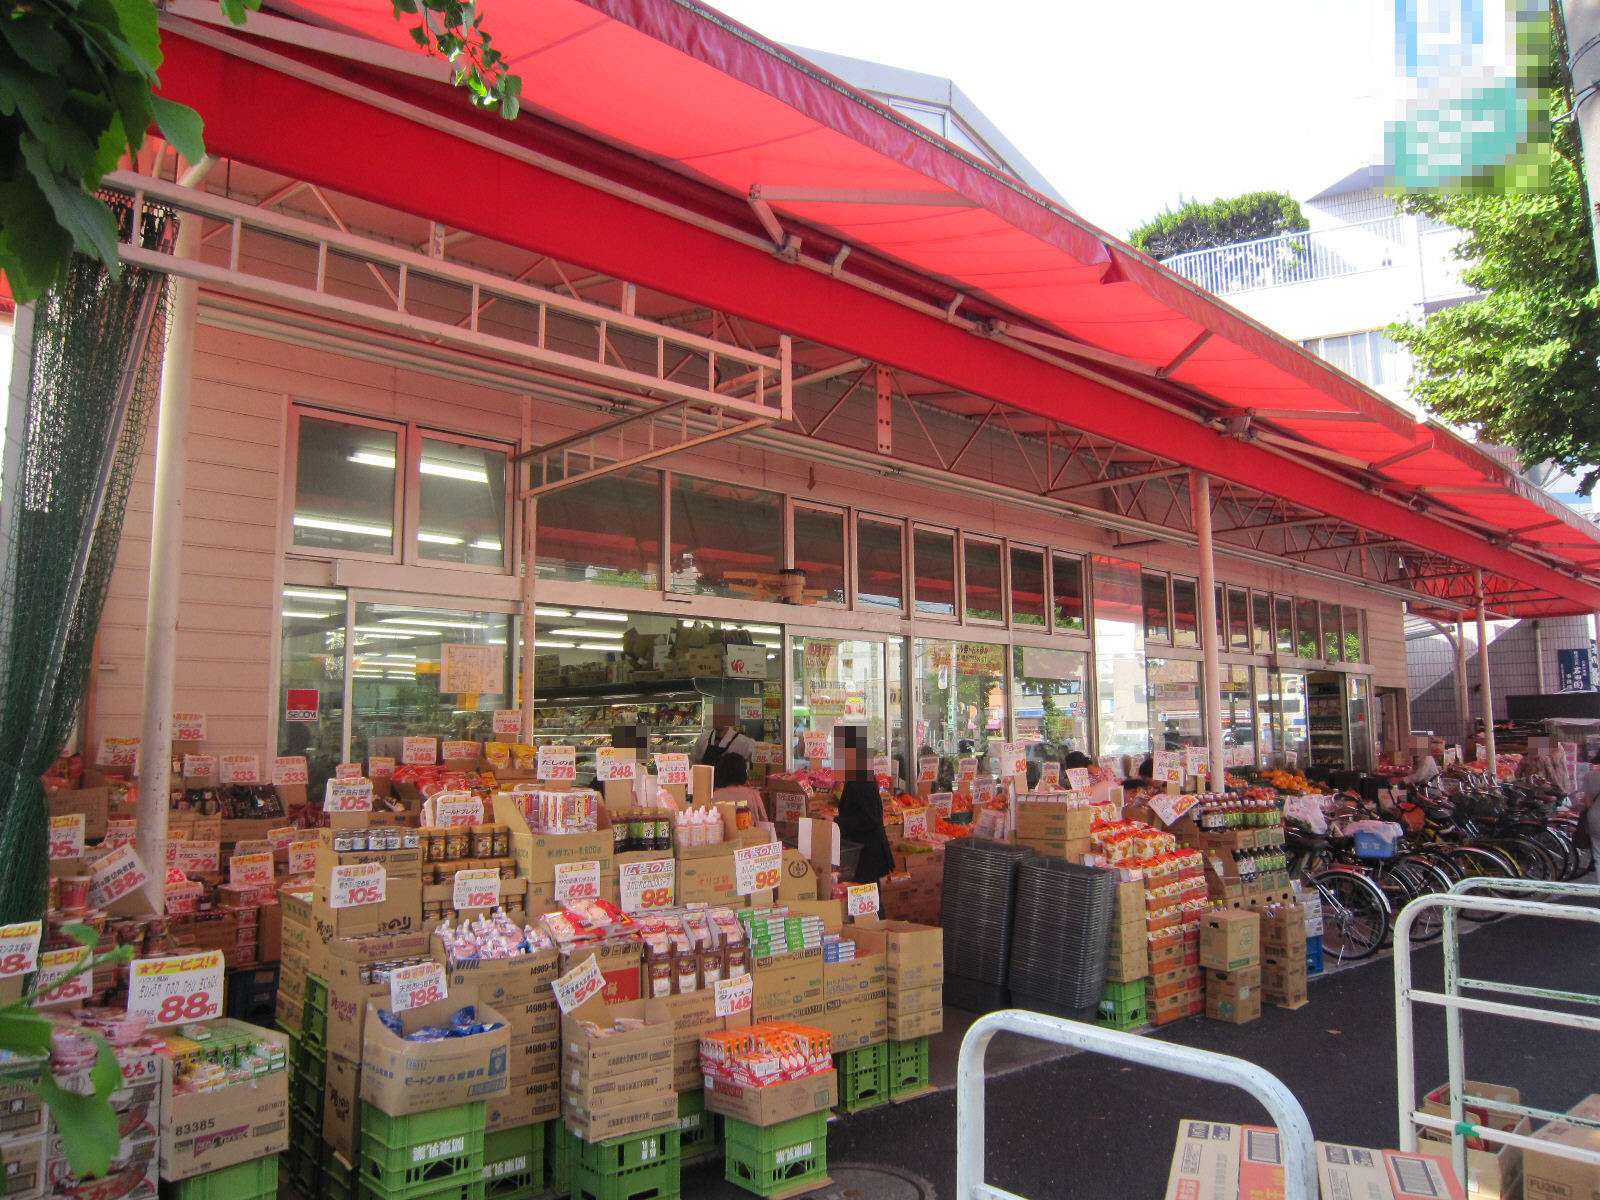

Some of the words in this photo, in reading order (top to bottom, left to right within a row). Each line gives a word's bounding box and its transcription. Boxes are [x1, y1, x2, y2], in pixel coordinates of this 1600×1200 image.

[288, 710, 317, 719] SECOM
[747, 709, 761, 718] 98
[178, 729, 204, 739] 198
[414, 753, 433, 762] 148
[232, 771, 256, 782] 333
[551, 766, 575, 778] 378
[610, 765, 633, 778] 248
[283, 772, 307, 783] 333
[667, 772, 688, 783] 333
[340, 796, 370, 810] 105
[451, 815, 479, 826] 378
[911, 823, 926, 836] 98
[189, 859, 217, 869] 79
[456, 959, 480, 970] VITAL
[719, 988, 752, 1000] タバスコ
[158, 991, 217, 1023] 88円
[175, 1118, 215, 1136] 83385
